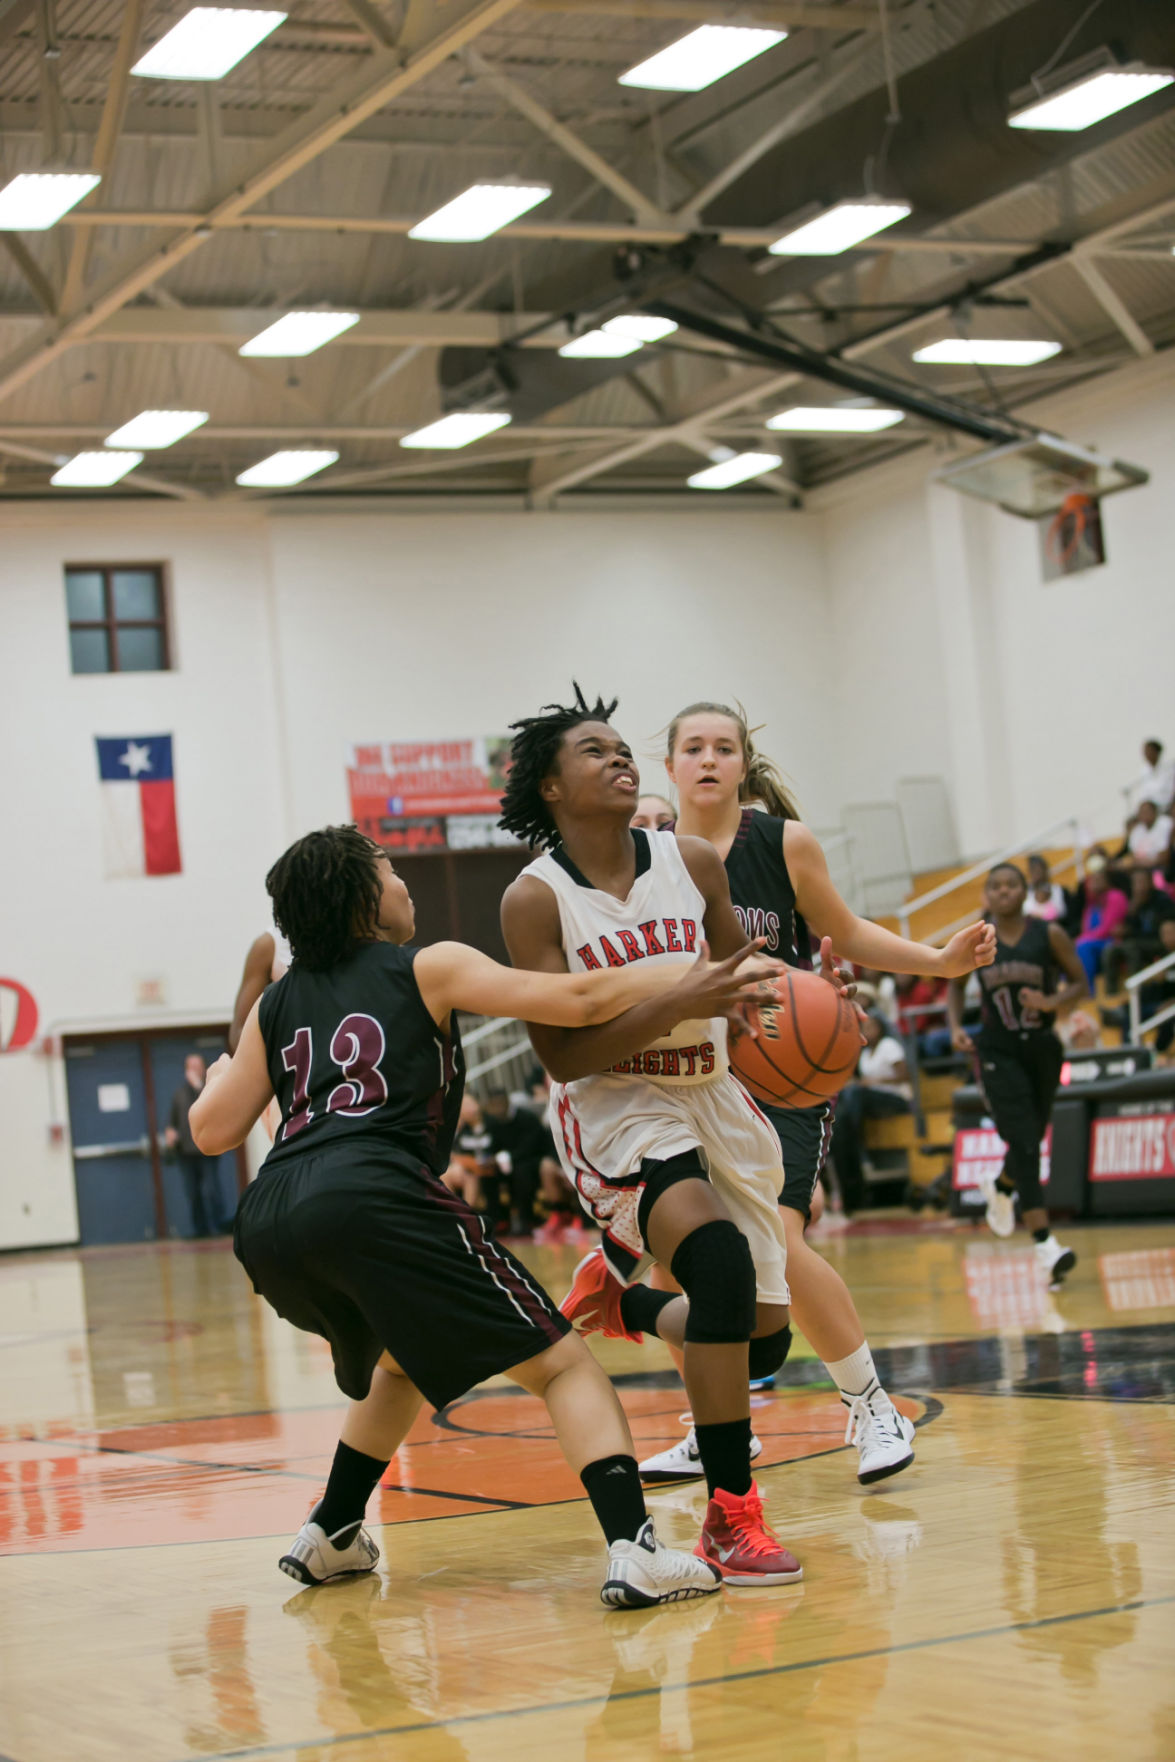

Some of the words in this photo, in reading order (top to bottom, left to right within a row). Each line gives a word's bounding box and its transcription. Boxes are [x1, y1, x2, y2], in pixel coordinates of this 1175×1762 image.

[576, 918, 697, 972] HARKER
[281, 1012, 389, 1141] 13
[600, 1041, 715, 1077] EIGHTS
